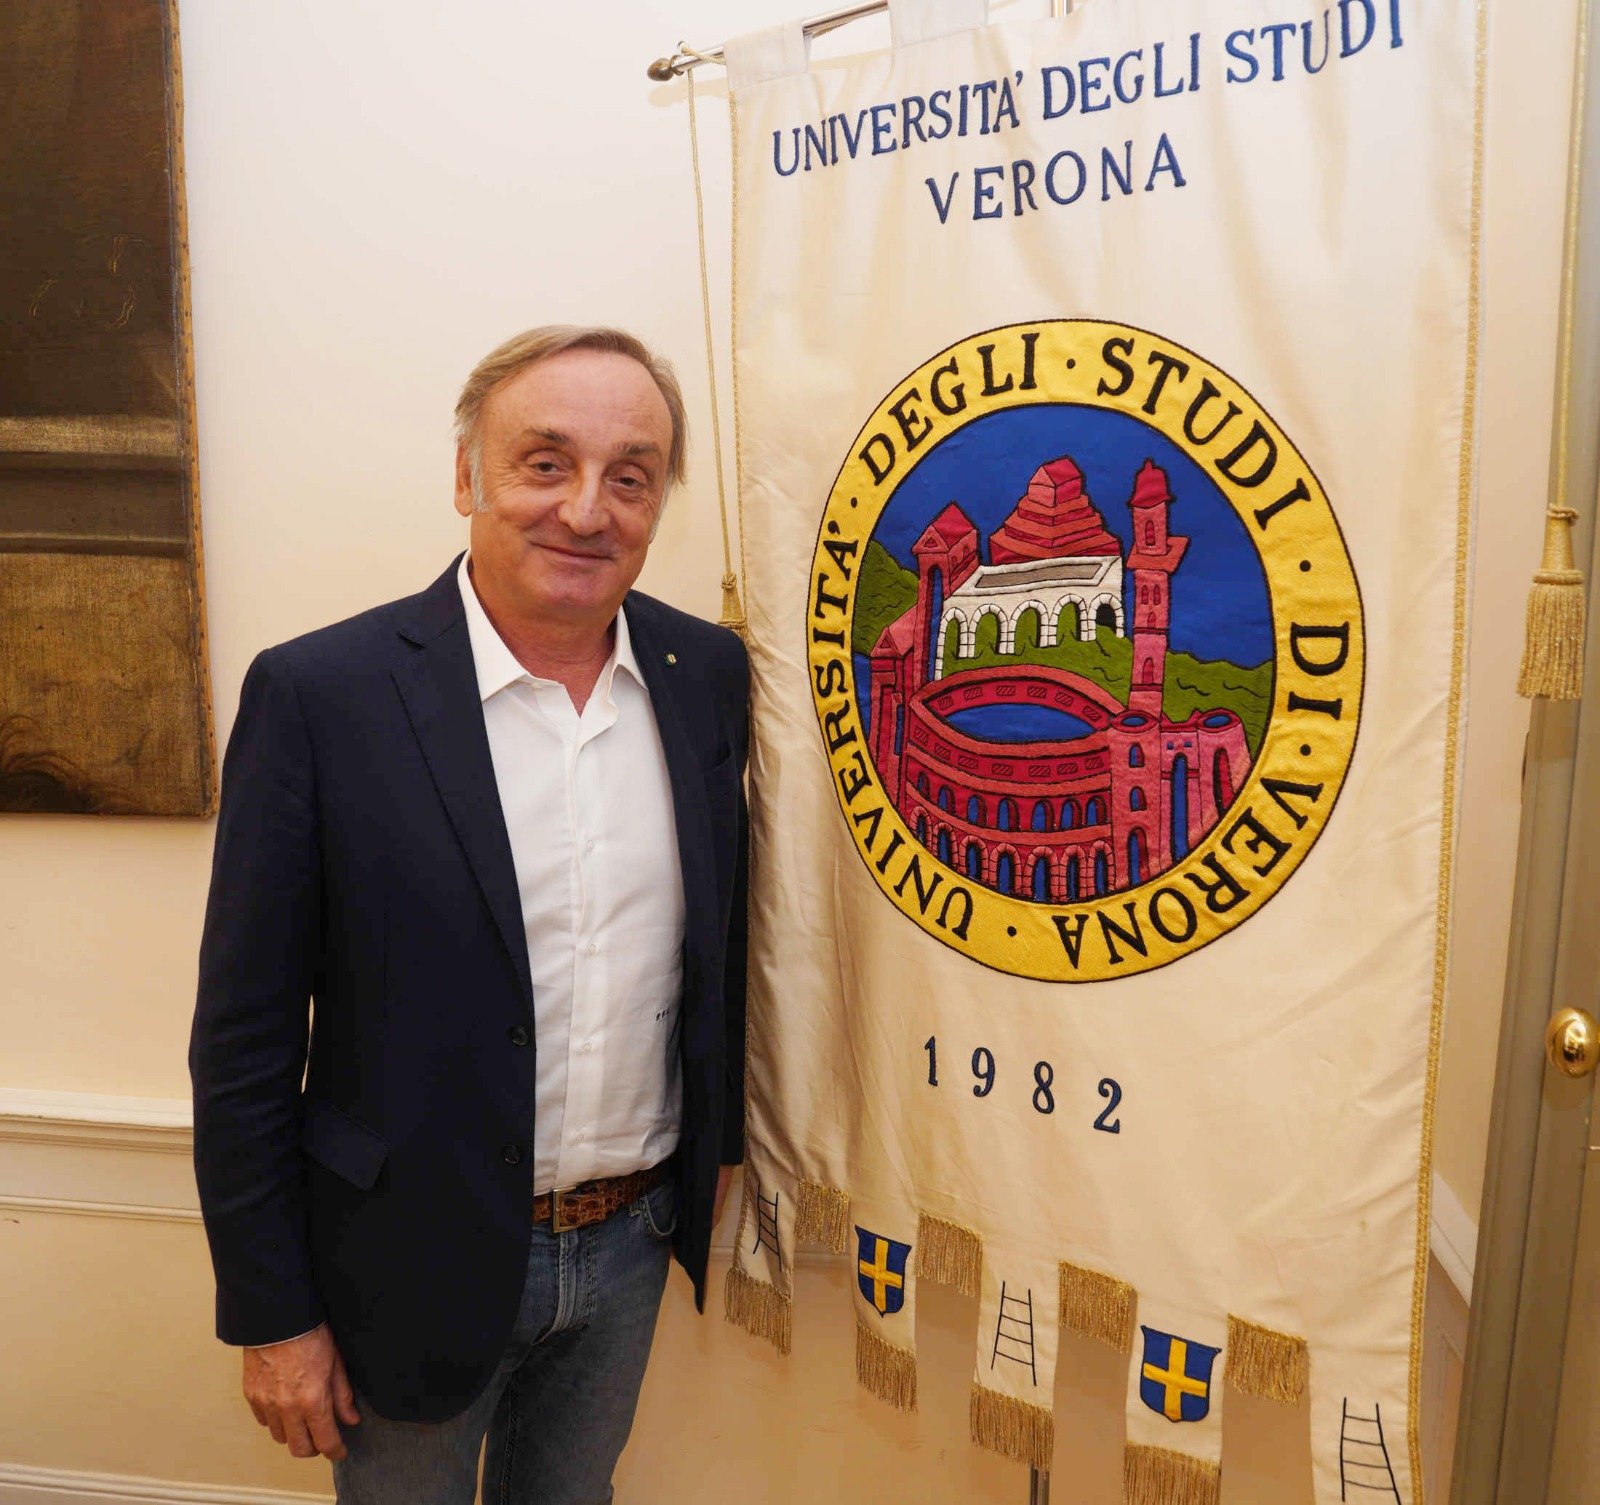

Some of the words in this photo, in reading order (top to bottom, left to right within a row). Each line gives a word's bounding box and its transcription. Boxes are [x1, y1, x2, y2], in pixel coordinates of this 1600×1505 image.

[1042, 33, 1201, 120] DEGLI
[1225, 0, 1404, 85] STUDI
[926, 132, 1187, 224] VERONA
[859, 332, 1040, 487] DEGLI
[1097, 338, 1312, 530] STUDI
[1288, 621, 1350, 720] DI
[1052, 777, 1325, 969] VERONA
